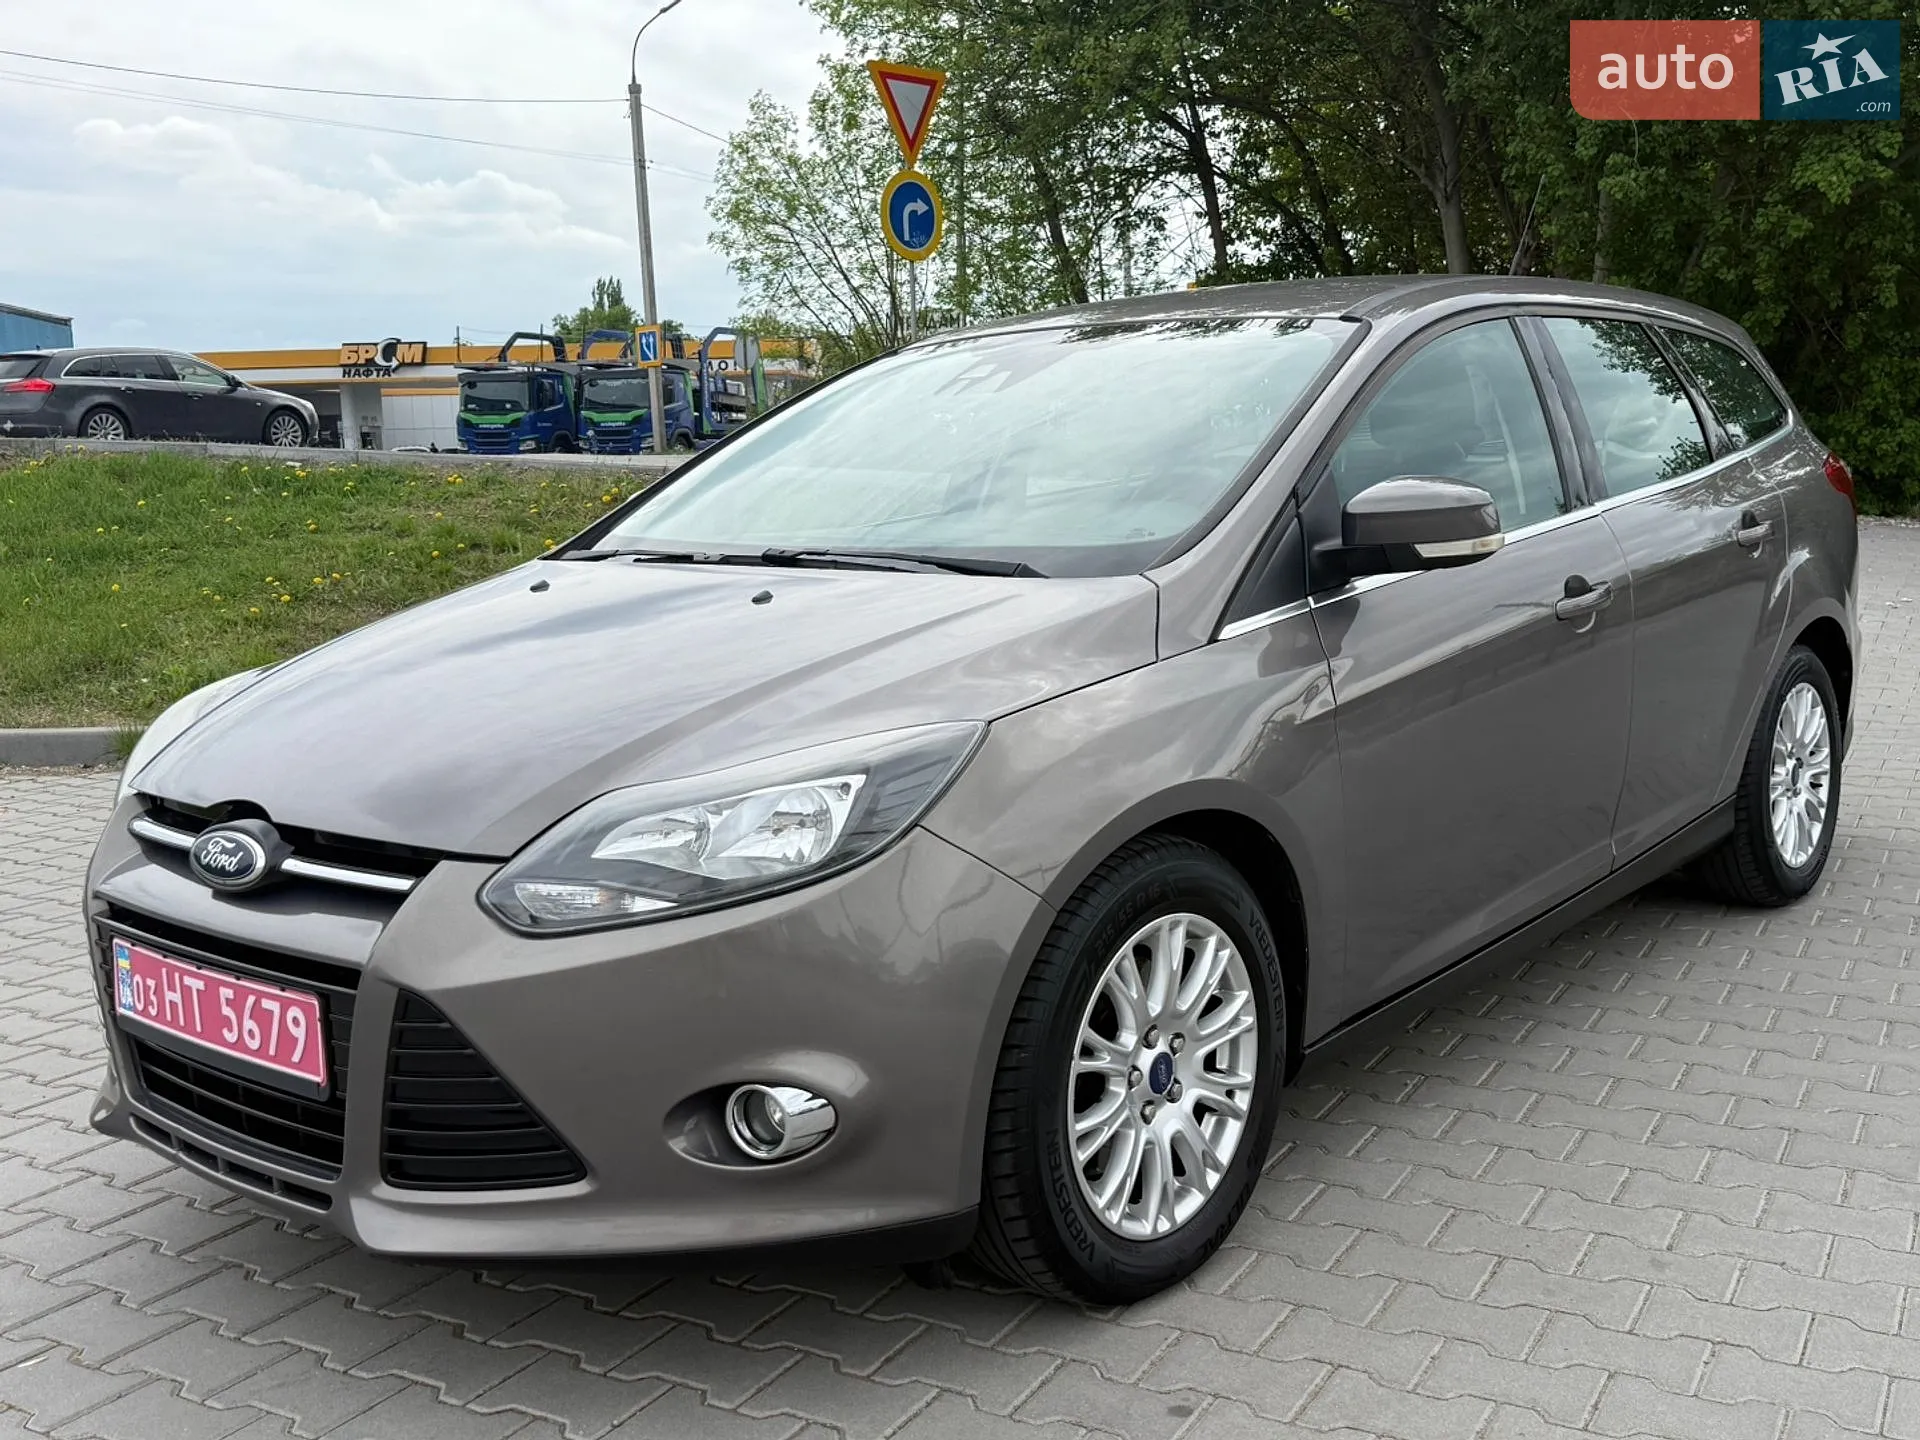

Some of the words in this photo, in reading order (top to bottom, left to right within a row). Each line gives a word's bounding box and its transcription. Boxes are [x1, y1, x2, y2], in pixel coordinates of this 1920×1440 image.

[342, 368, 392, 378] НАФТА
[198, 837, 243, 873] Ford
[1249, 908, 1286, 1033] VREDESTEIN
[219, 986, 308, 1064] 5679
[1046, 1127, 1096, 1263] VREDESTEIN
